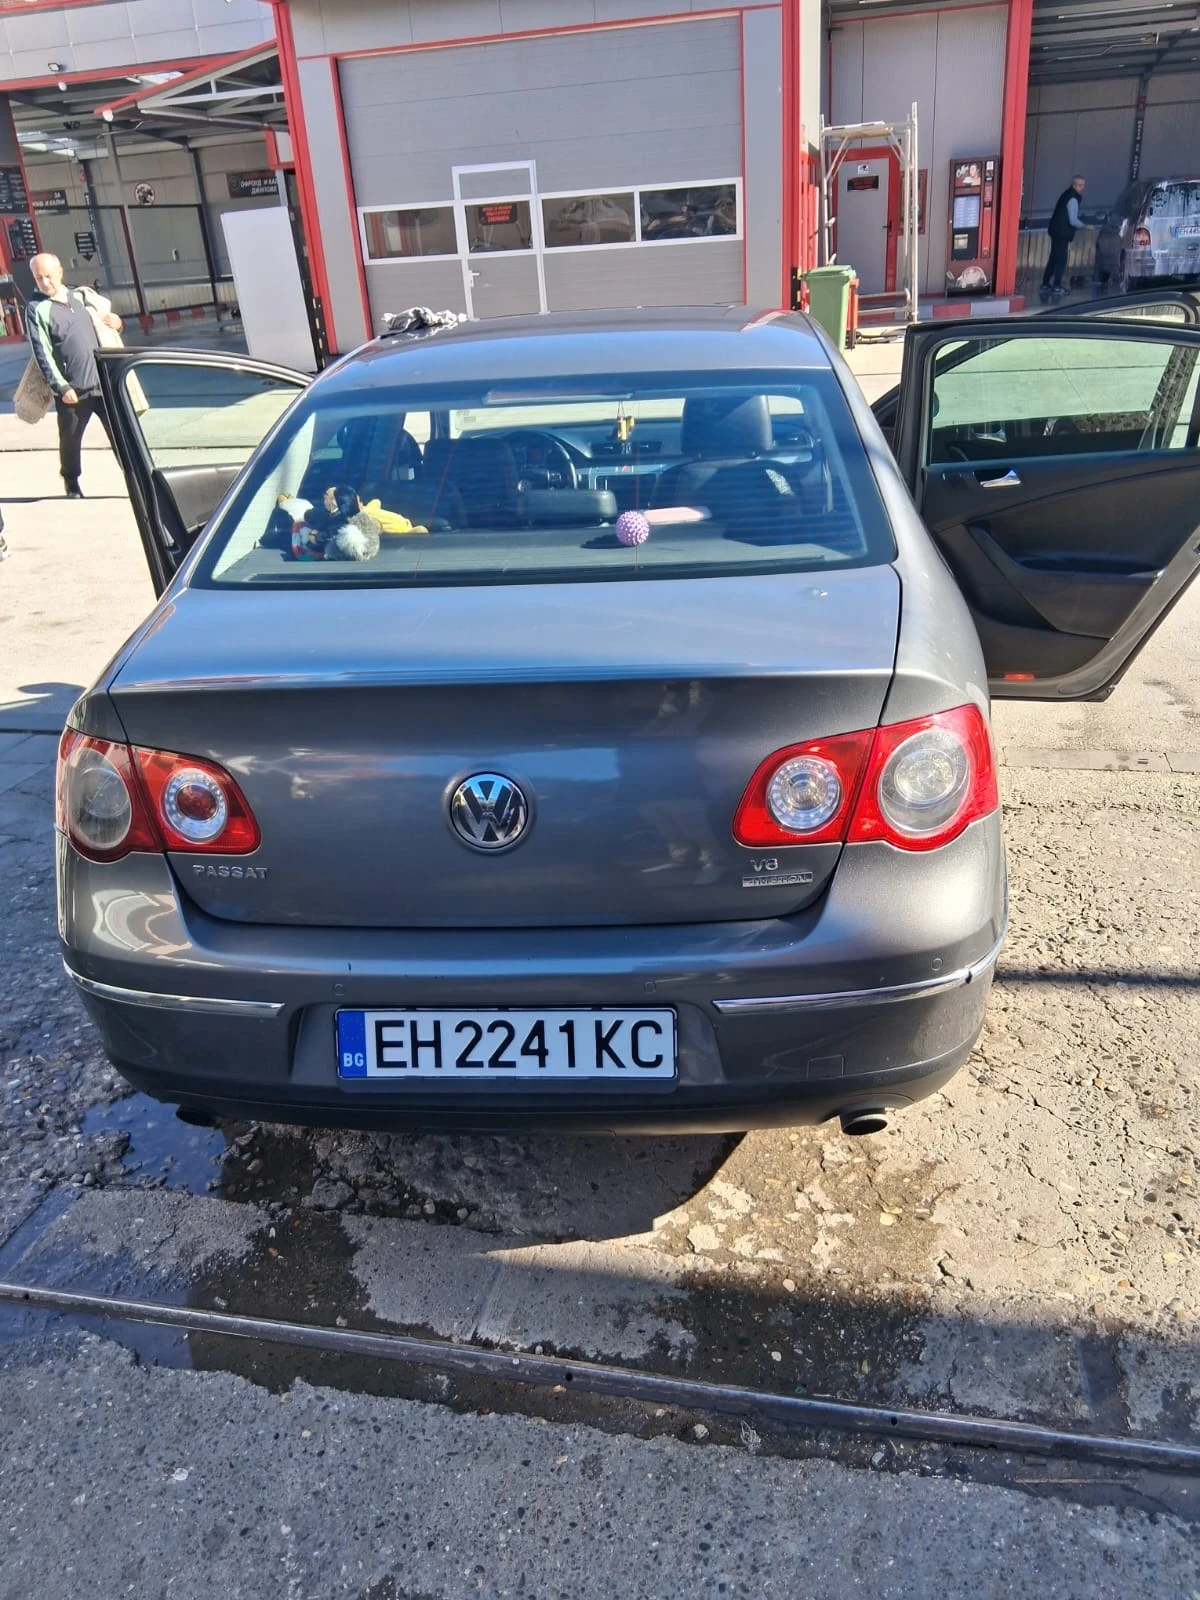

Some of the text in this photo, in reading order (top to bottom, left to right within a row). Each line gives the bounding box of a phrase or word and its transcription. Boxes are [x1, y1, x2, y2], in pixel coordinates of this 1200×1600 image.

[192, 864, 269, 879] PASSAT
[374, 1019, 664, 1070] EH 2241 KC
[342, 1052, 365, 1068] BG
